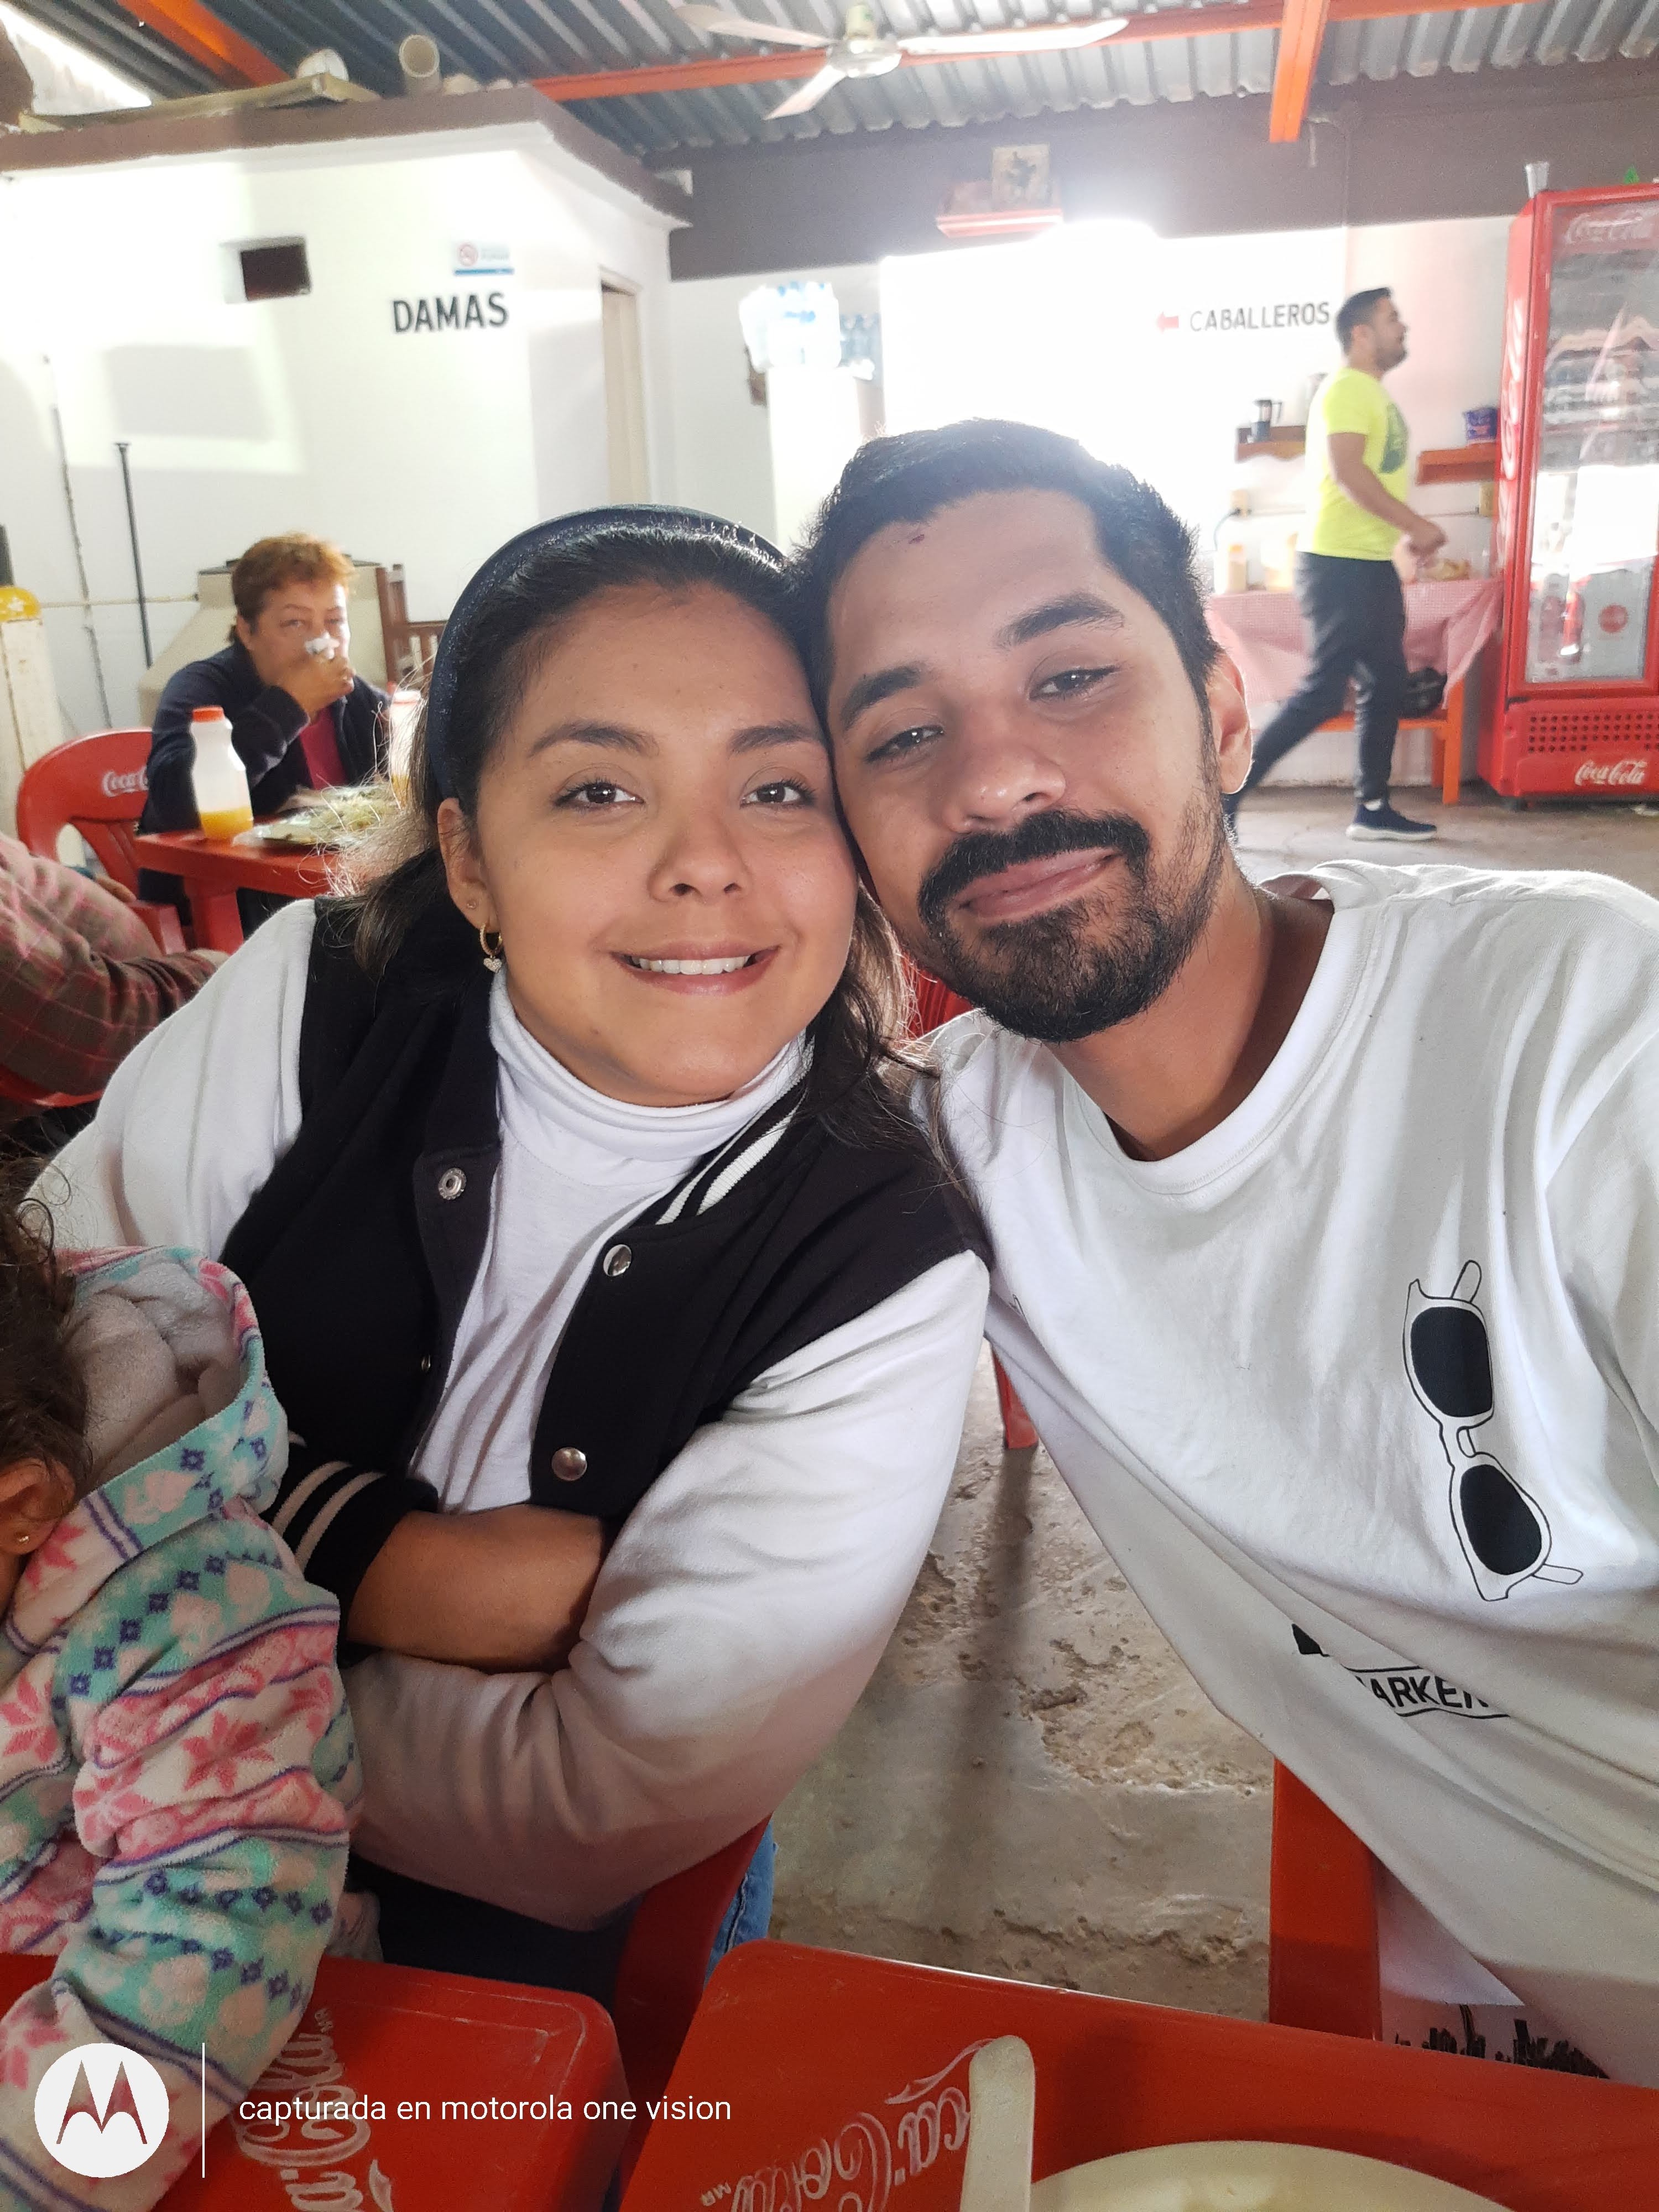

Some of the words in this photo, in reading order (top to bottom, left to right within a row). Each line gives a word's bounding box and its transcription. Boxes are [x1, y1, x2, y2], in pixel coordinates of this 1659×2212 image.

[393, 291, 509, 333] DAMAS
[1190, 301, 1330, 332] CABALLEROS
[1355, 1675, 1489, 1709] ARKE
